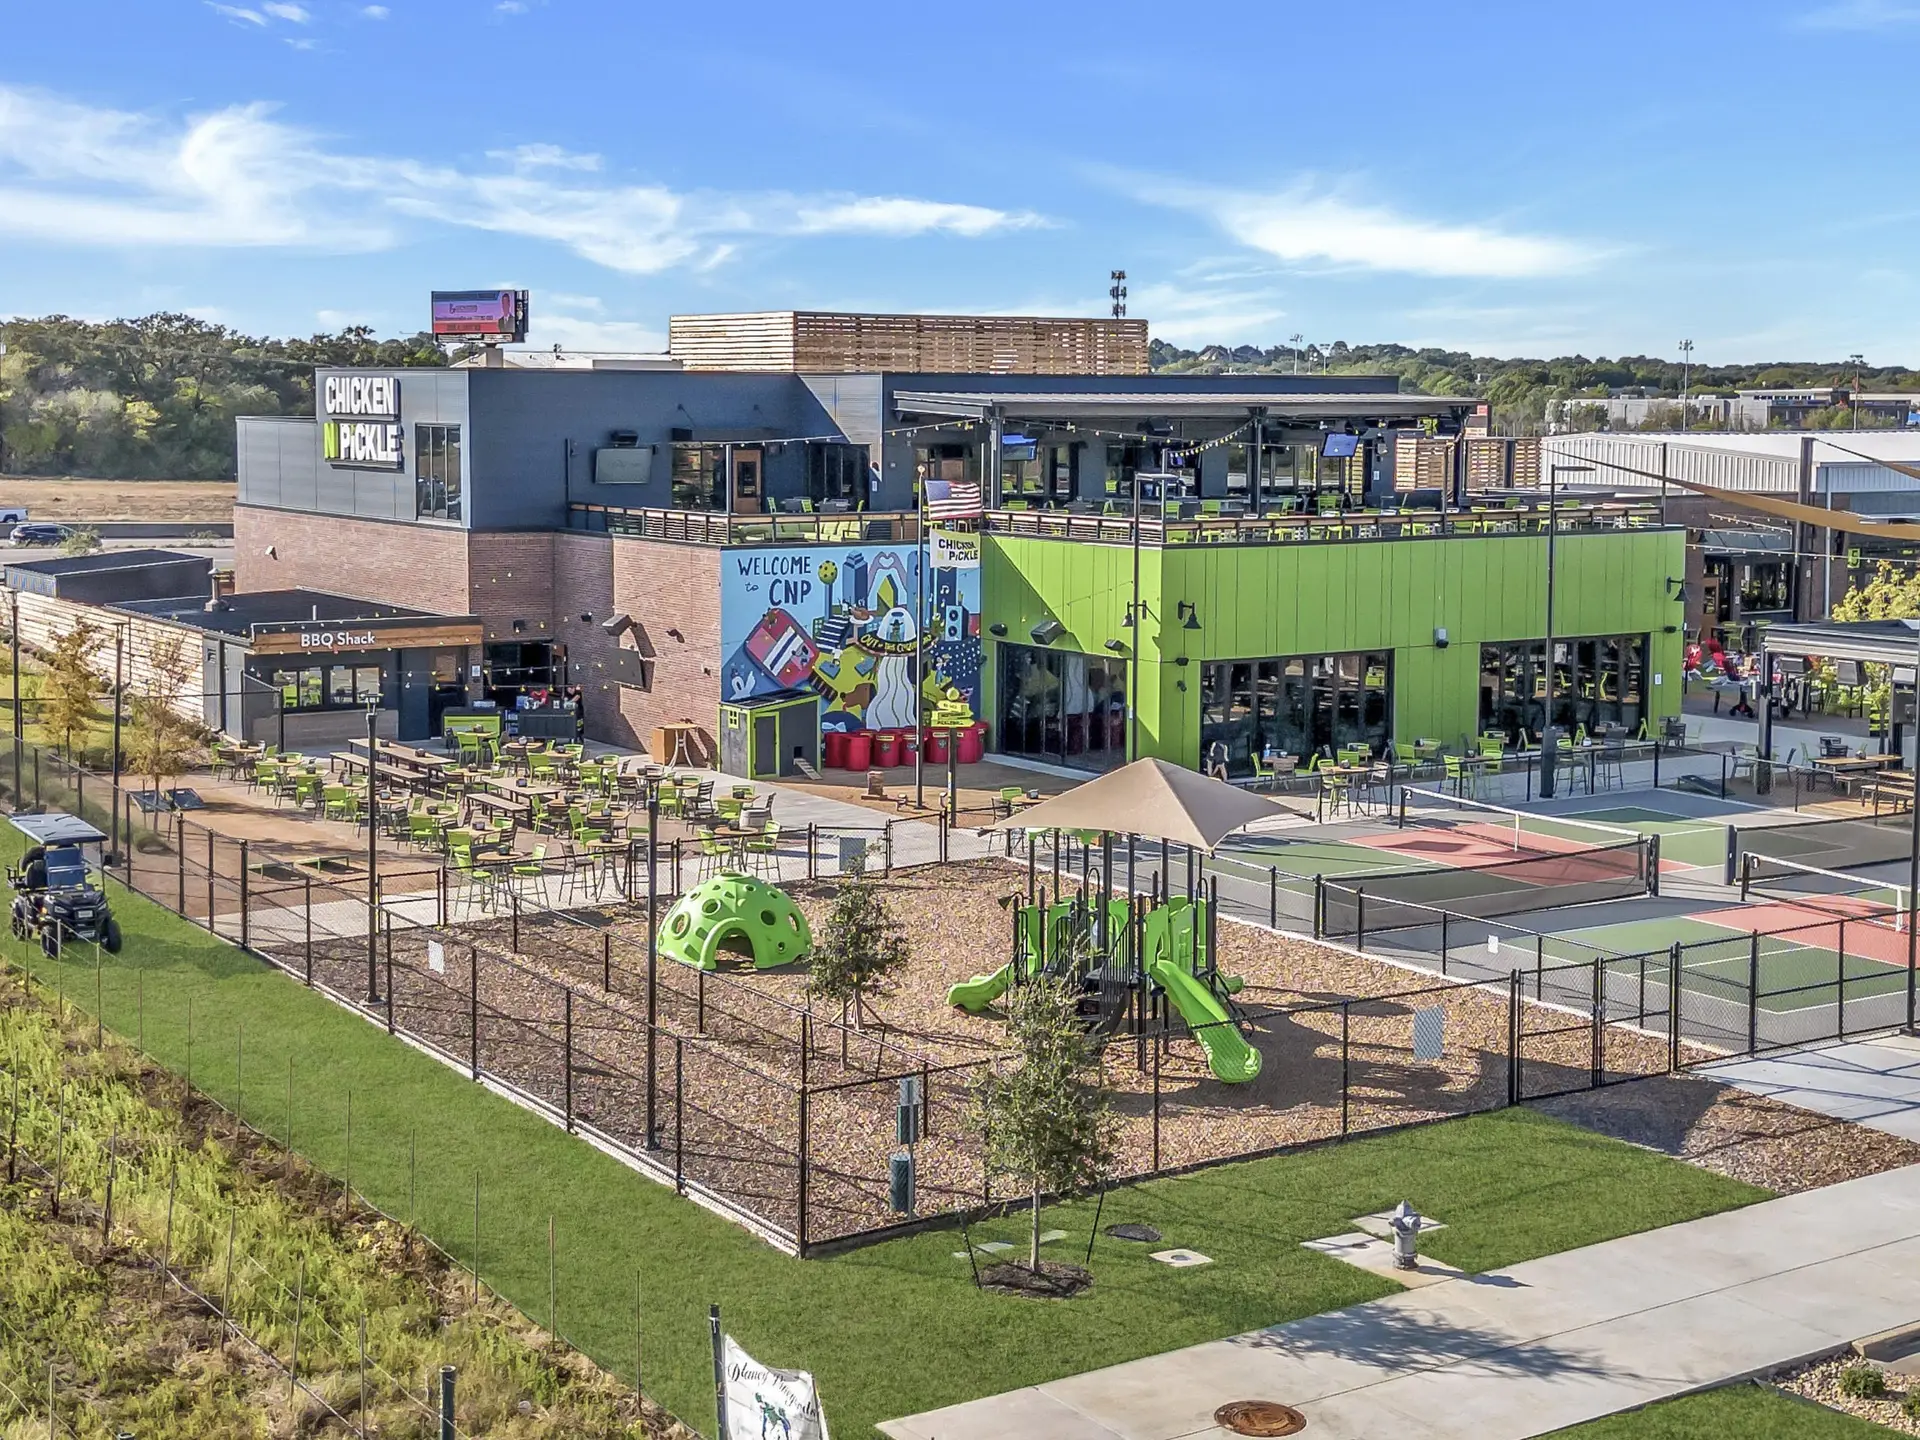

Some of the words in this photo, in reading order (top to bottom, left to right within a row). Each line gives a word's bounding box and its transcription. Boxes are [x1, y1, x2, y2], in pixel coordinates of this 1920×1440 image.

[325, 376, 396, 415] CHICKEN
[323, 422, 337, 459] N
[737, 556, 811, 576] WELCOME
[745, 581, 759, 592] to
[769, 578, 812, 606] CNP
[301, 633, 333, 649] BBQ
[337, 631, 376, 646] Shack
[1404, 790, 1411, 800] 2
